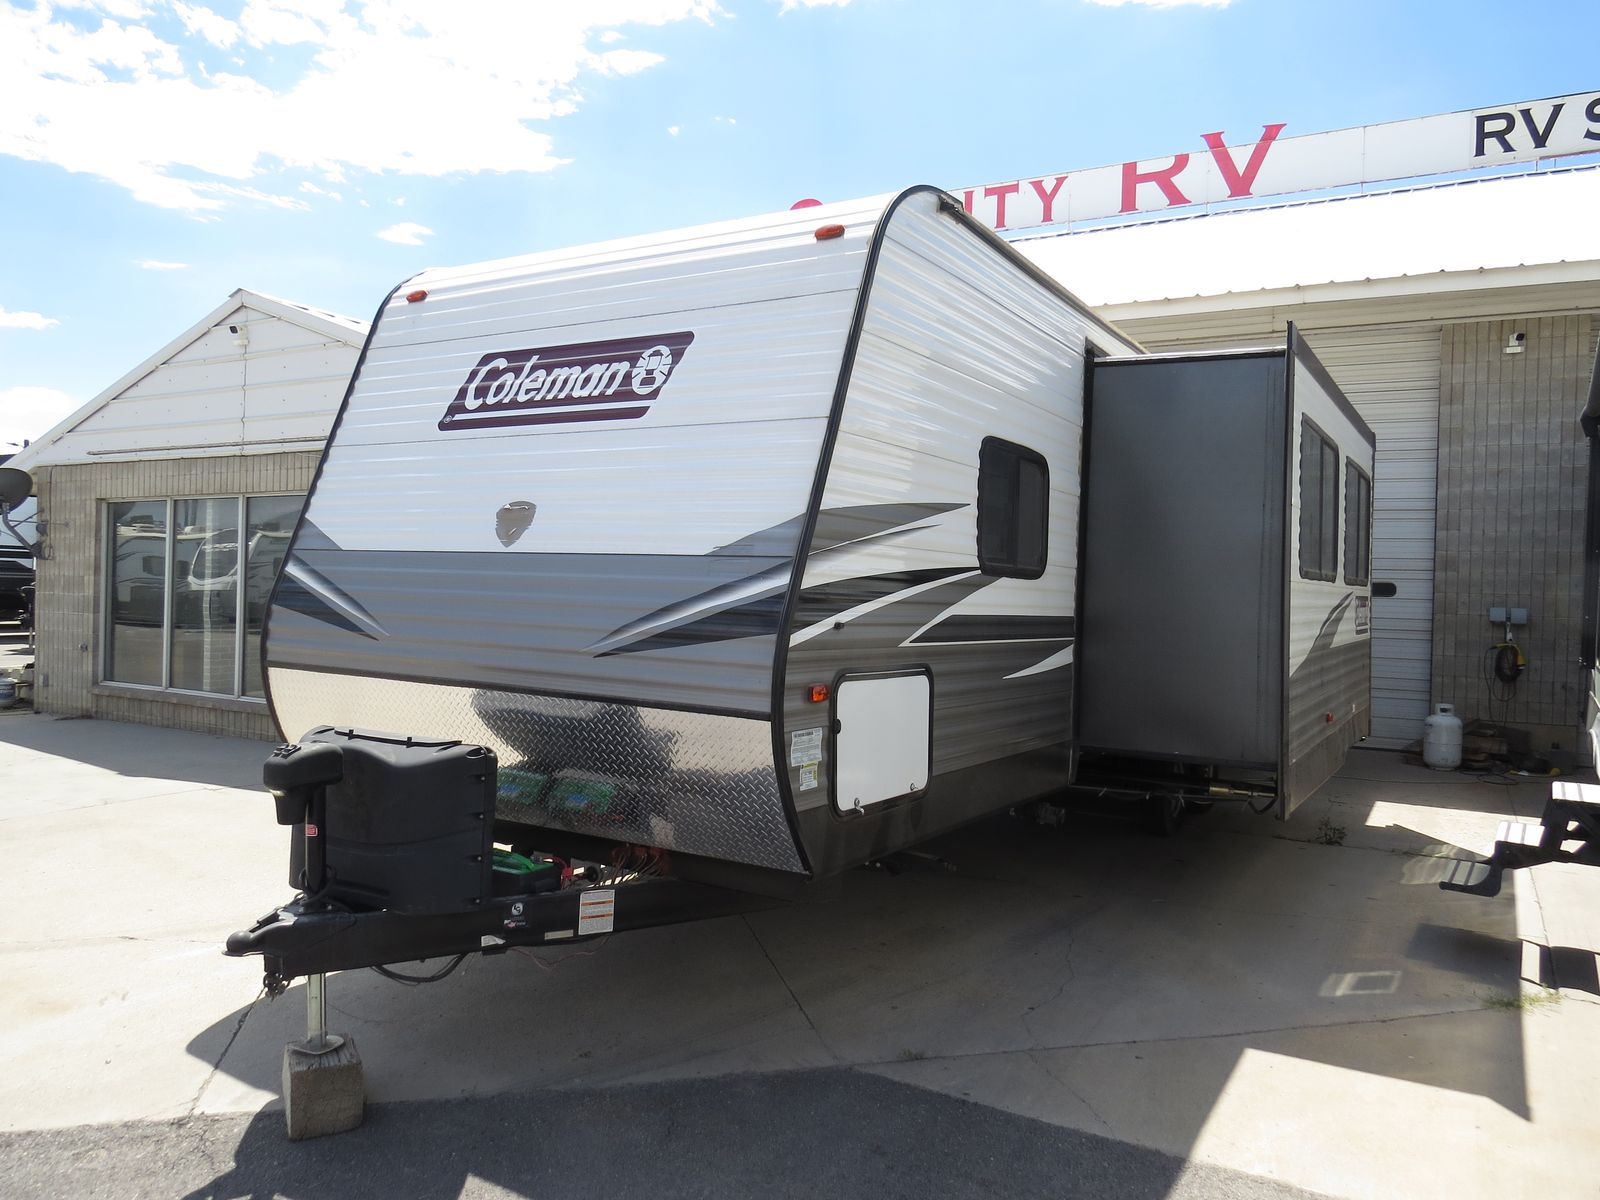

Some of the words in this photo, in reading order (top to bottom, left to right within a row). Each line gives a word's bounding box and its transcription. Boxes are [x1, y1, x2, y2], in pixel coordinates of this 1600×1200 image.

[1474, 103, 1566, 157] RV
[963, 176, 1069, 229] ITY
[1119, 123, 1287, 213] RV
[464, 354, 631, 410] Coleman
